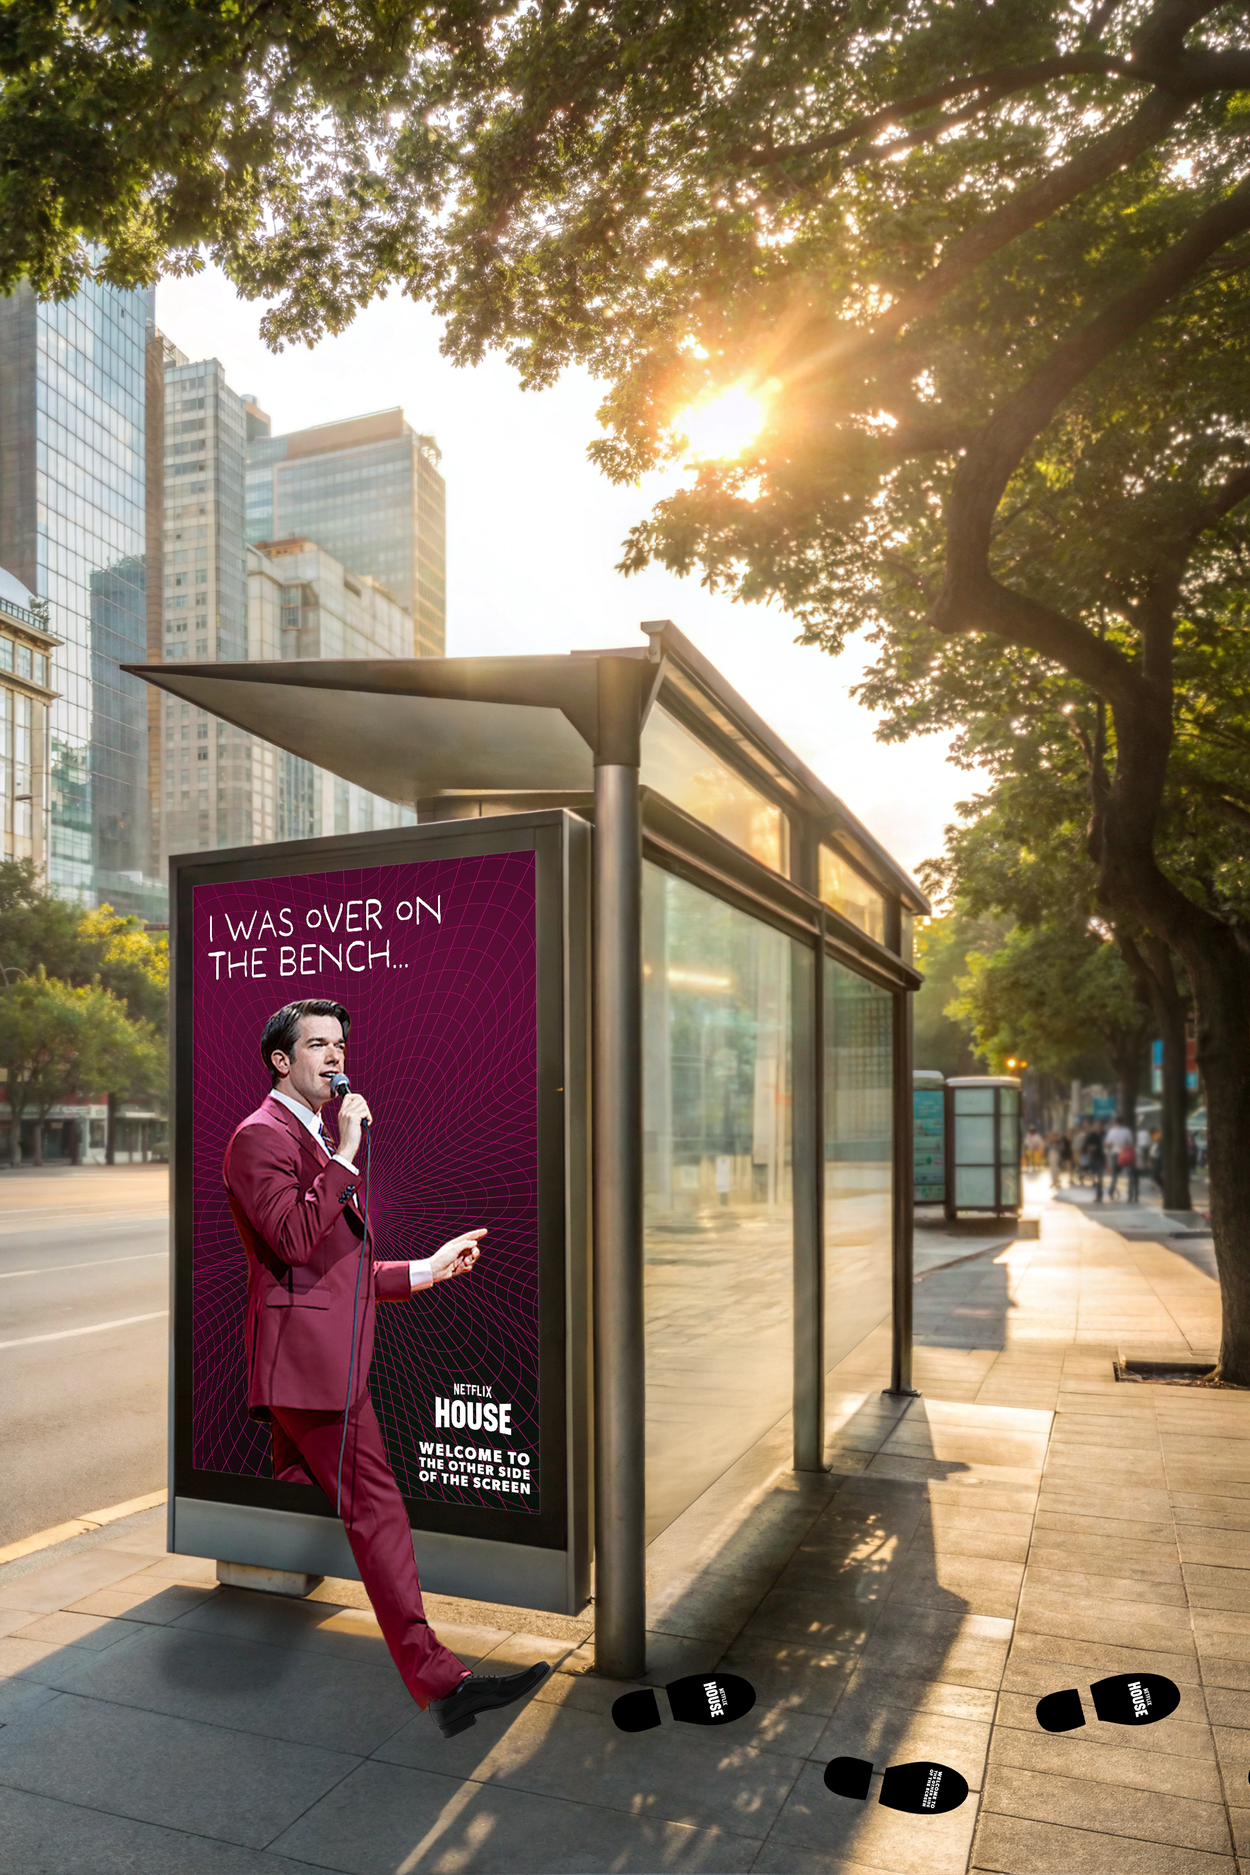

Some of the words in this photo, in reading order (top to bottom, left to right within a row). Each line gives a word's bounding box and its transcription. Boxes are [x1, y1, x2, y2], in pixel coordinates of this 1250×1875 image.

[209, 915, 214, 943] I
[225, 908, 294, 942] WAS
[306, 898, 383, 933] OVER
[395, 894, 442, 926] ON
[207, 946, 268, 981] THE
[279, 939, 410, 978] BENCH...
[453, 1382, 493, 1399] NETFLIX
[434, 1396, 512, 1436] HOUSE
[418, 1441, 503, 1464] WELCOME
[507, 1450, 531, 1467] TO
[418, 1456, 445, 1470] THE
[447, 1460, 495, 1477] OTHER
[498, 1466, 531, 1481] SIDE
[418, 1470, 438, 1483] OF
[441, 1472, 469, 1487] THE
[472, 1476, 531, 1495] SCREEN
[703, 1681, 724, 1717] HOUSE
[1127, 1681, 1148, 1717] HOUSE
[932, 1772, 942, 1800] WELCOME
